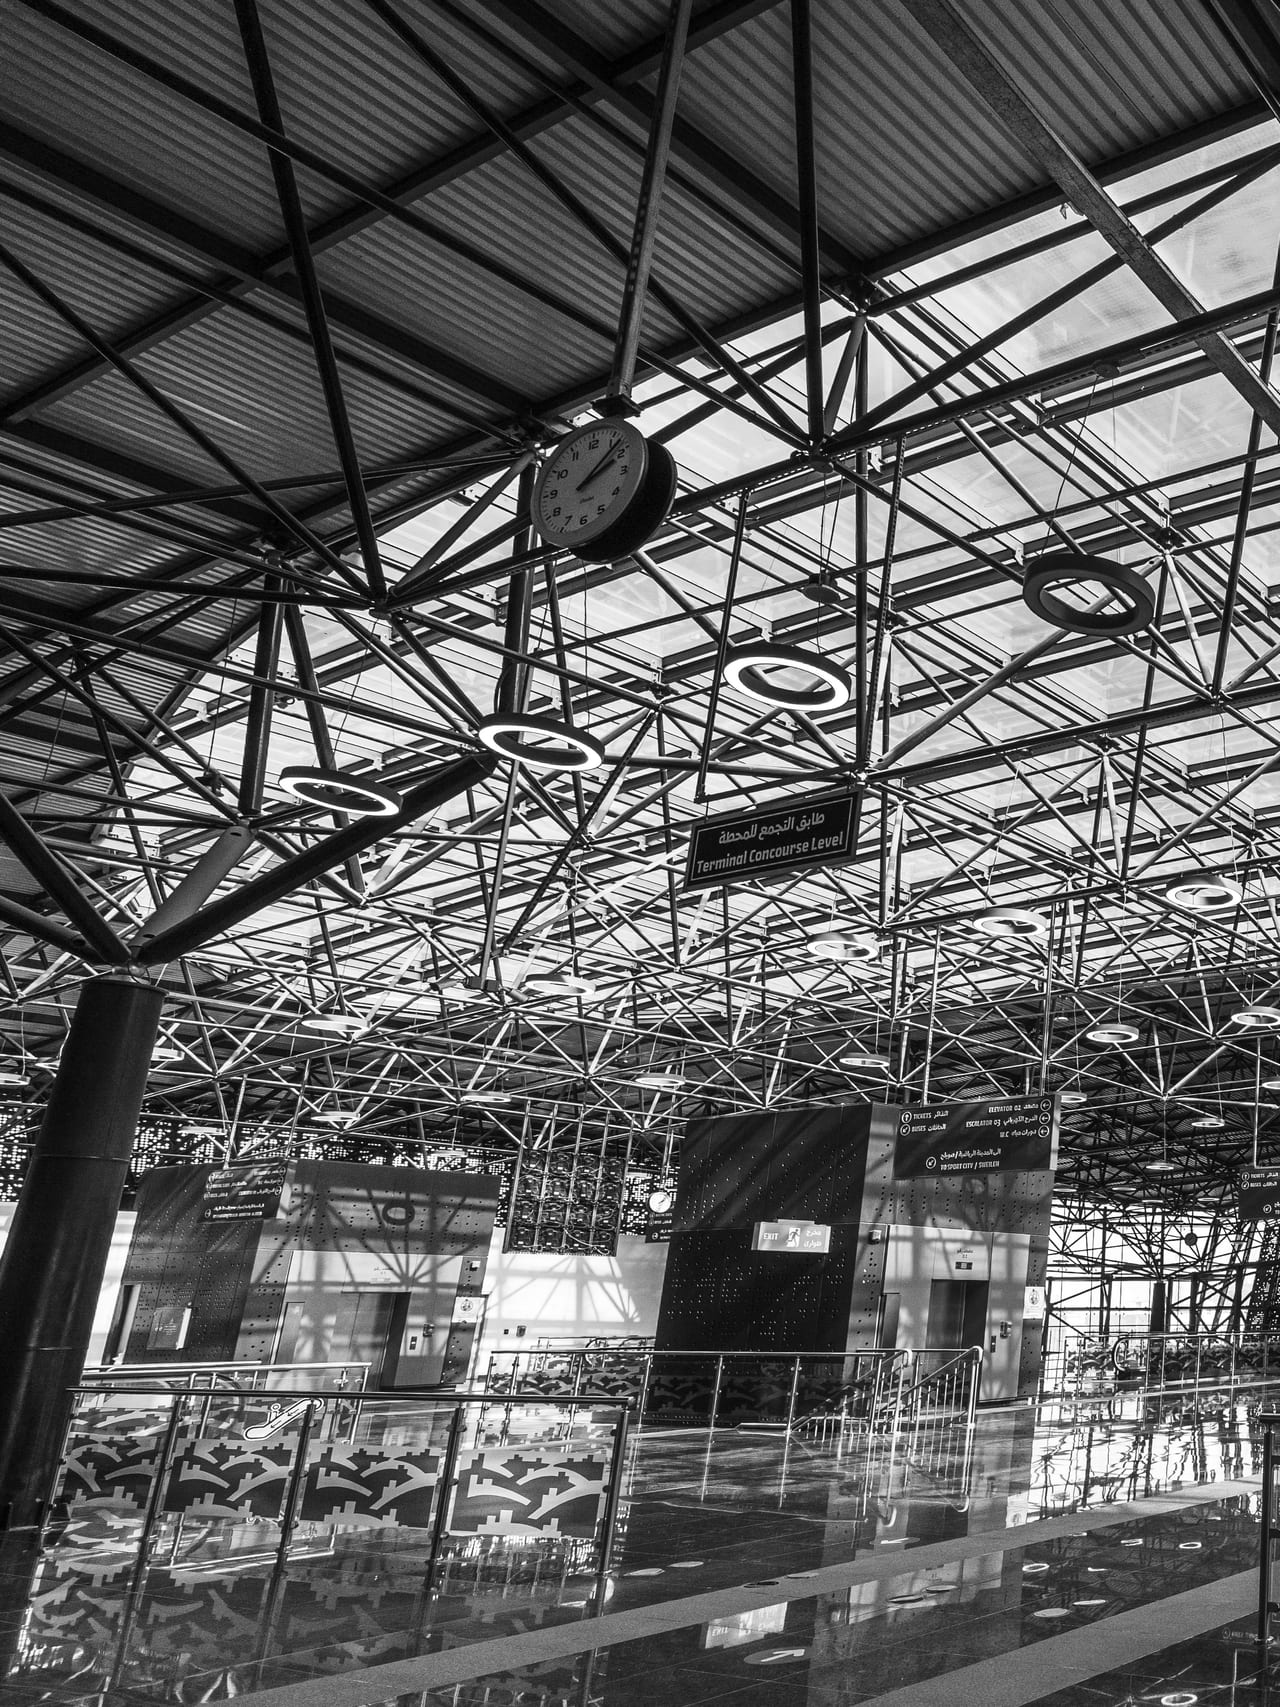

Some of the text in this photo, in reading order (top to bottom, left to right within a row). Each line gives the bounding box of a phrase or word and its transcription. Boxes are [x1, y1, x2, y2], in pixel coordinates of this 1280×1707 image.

[588, 440, 600, 450] 12
[572, 451, 579, 462] 11
[617, 448, 625, 459] 2
[557, 469, 568, 480] 10
[620, 465, 628, 476] 3
[550, 489, 558, 499] 9
[612, 486, 620, 496] 4
[553, 507, 561, 517] 8
[597, 504, 606, 515] 5
[565, 515, 573, 526] 7
[580, 515, 588, 525] 6
[718, 812, 825, 844] طابق التجمع للمحطة
[697, 832, 844, 874] Terminal Concourse Level
[988, 1105, 1012, 1113] ELEVATOR
[763, 1232, 779, 1240] EXIT
